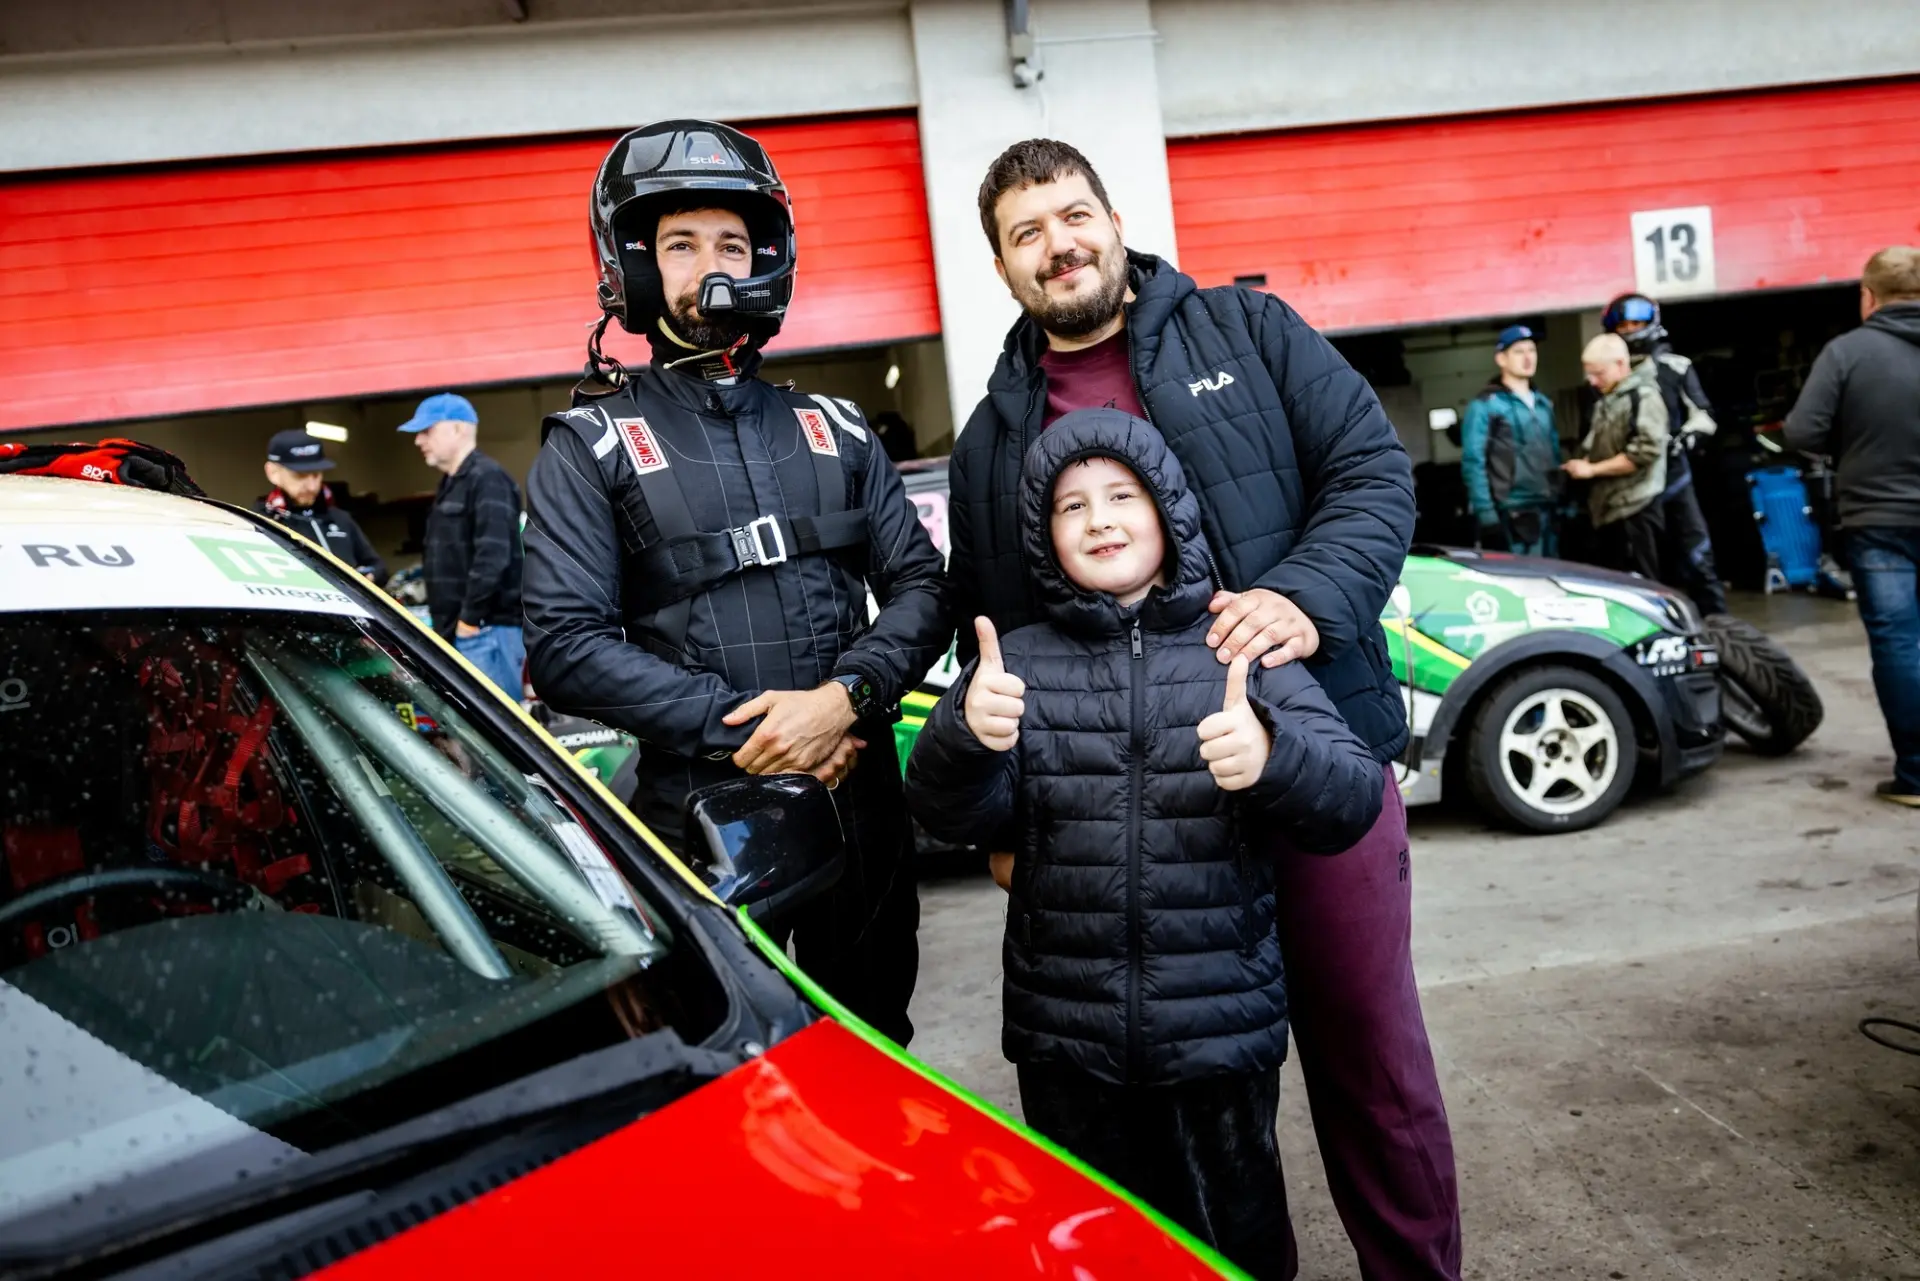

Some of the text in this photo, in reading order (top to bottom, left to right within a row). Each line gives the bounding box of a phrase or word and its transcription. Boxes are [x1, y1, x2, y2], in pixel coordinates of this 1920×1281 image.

[1645, 223, 1700, 284] 13
[1188, 371, 1235, 397] FILA
[625, 424, 657, 465] SIMPSON
[804, 413, 830, 449] SIMPSON
[243, 583, 353, 603] integra
[557, 729, 619, 748] OKOHAMA
